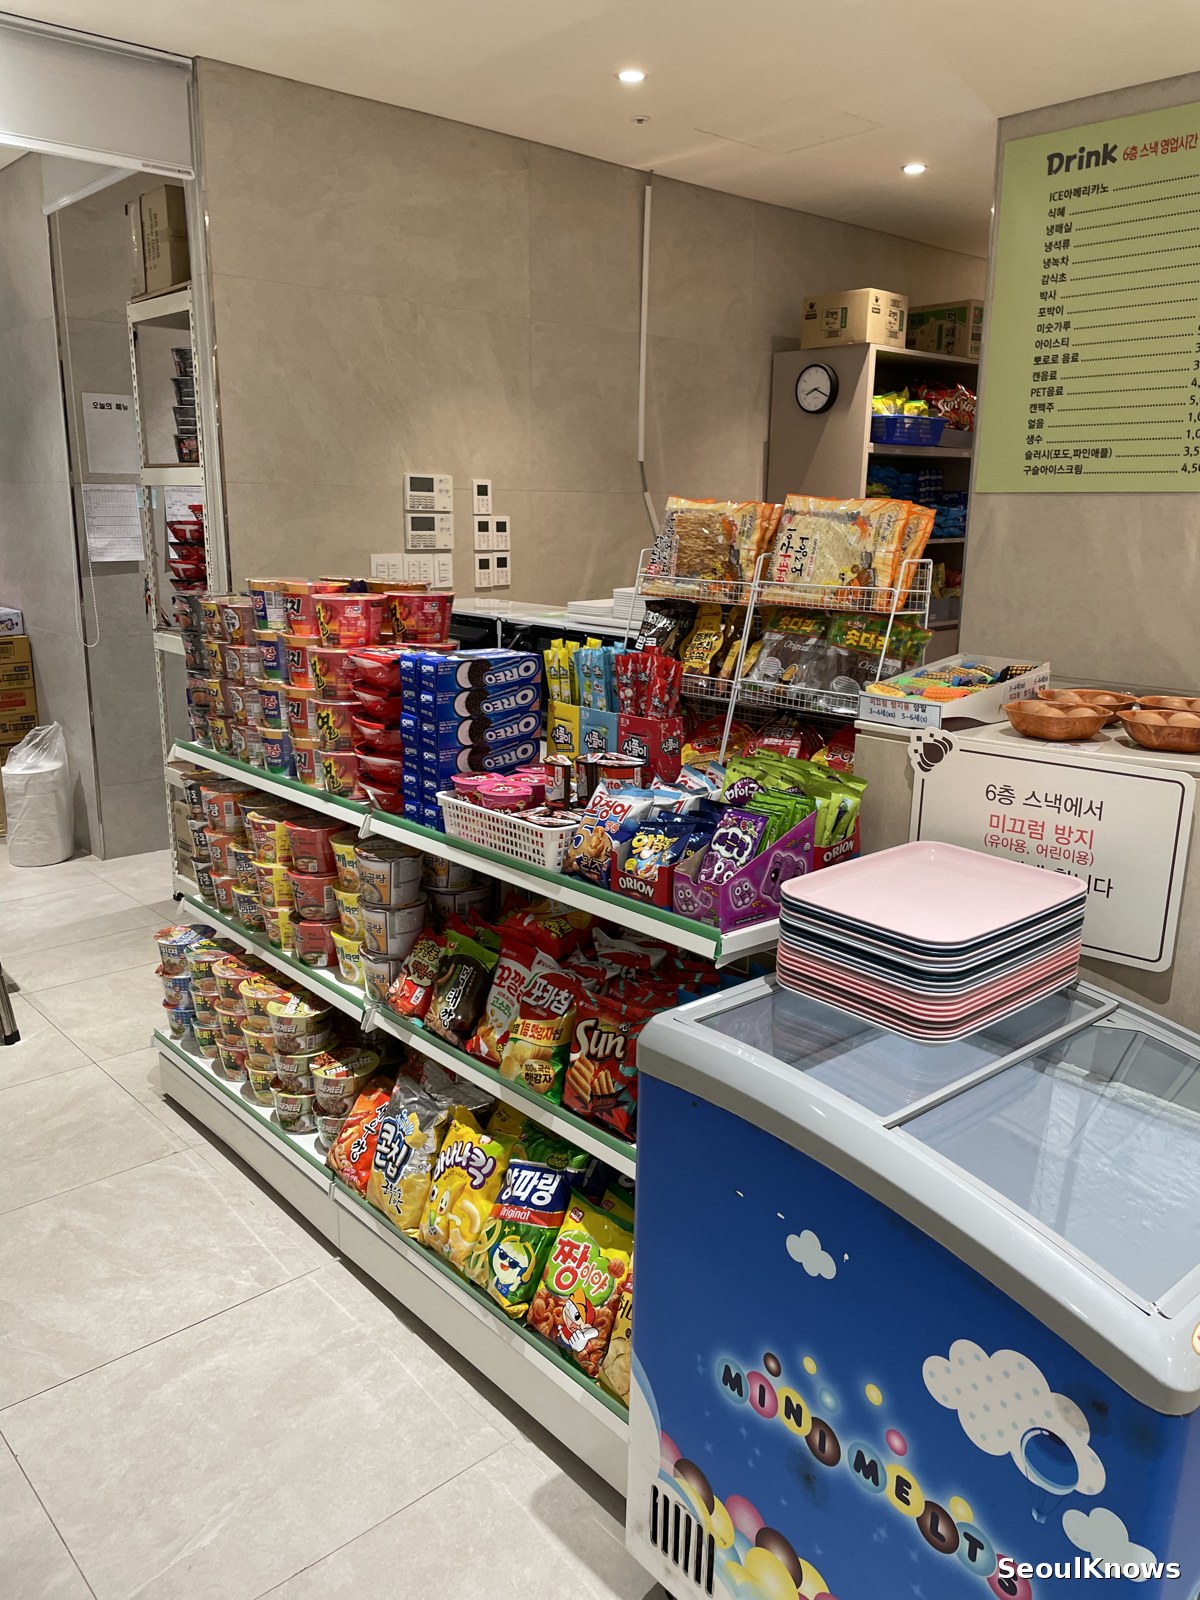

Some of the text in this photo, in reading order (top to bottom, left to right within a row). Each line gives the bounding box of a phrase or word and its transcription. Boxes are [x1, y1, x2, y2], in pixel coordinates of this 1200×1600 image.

[1122, 132, 1199, 161] 6층 스낵 영업시간
[1047, 143, 1118, 175] Drink
[1049, 183, 1109, 202] ICE아메리카노
[1048, 206, 1066, 219] 식혜
[1046, 222, 1073, 236] 냉매실
[1044, 238, 1071, 253] 냉석류
[1043, 255, 1069, 269] 냉녹차
[1041, 273, 1067, 285] 감식초
[1036, 320, 1071, 334] 미숫가루
[1035, 337, 1070, 350] 아이스티
[1033, 354, 1059, 366] 뽀로로
[1061, 352, 1079, 364] 음료
[1032, 370, 1057, 382] 캔음료
[1031, 386, 1064, 397] PET음료
[92, 401, 112, 410] 오늘의
[938, 398, 958, 417] Sun
[1029, 402, 1055, 413] 캔맥주
[1028, 419, 1045, 430] 얼음
[1026, 434, 1043, 445] 생수
[1024, 447, 1113, 460] 슬러시(포도,파인애플)
[1023, 464, 1083, 476] 구슬아이스크림
[775, 528, 809, 583] 버터구이 오징어
[484, 660, 537, 684] OREO
[858, 660, 898, 675] Original
[482, 688, 534, 713] OREO
[890, 699, 910, 711] 방지용
[912, 703, 928, 714] 양말
[485, 716, 536, 741] OREO
[484, 743, 534, 769] OREO
[724, 783, 766, 801] 마이구
[585, 794, 632, 823] 오징어
[985, 783, 1104, 822] 6층 스낵에서
[989, 813, 1094, 850] 미끄럼 방지
[823, 839, 855, 862] ORION
[984, 832, 1030, 855] (유아용,
[1036, 843, 1095, 867] 어린이용)
[618, 877, 655, 898] ORION
[440, 965, 474, 1030] 먹태깡
[521, 977, 575, 1016] 포카칩
[576, 1018, 626, 1060] Sun
[538, 1064, 551, 1073] 국산
[524, 1072, 553, 1087] 햇감자
[350, 1102, 389, 1162] 새우깡
[374, 1121, 409, 1178] 콘칩
[434, 1141, 495, 1187] 바나나킥
[501, 1168, 562, 1207] 양파링
[500, 1206, 531, 1220] Original
[552, 1237, 609, 1296] 짱이야
[722, 1364, 1019, 1597] MINI MELTS
